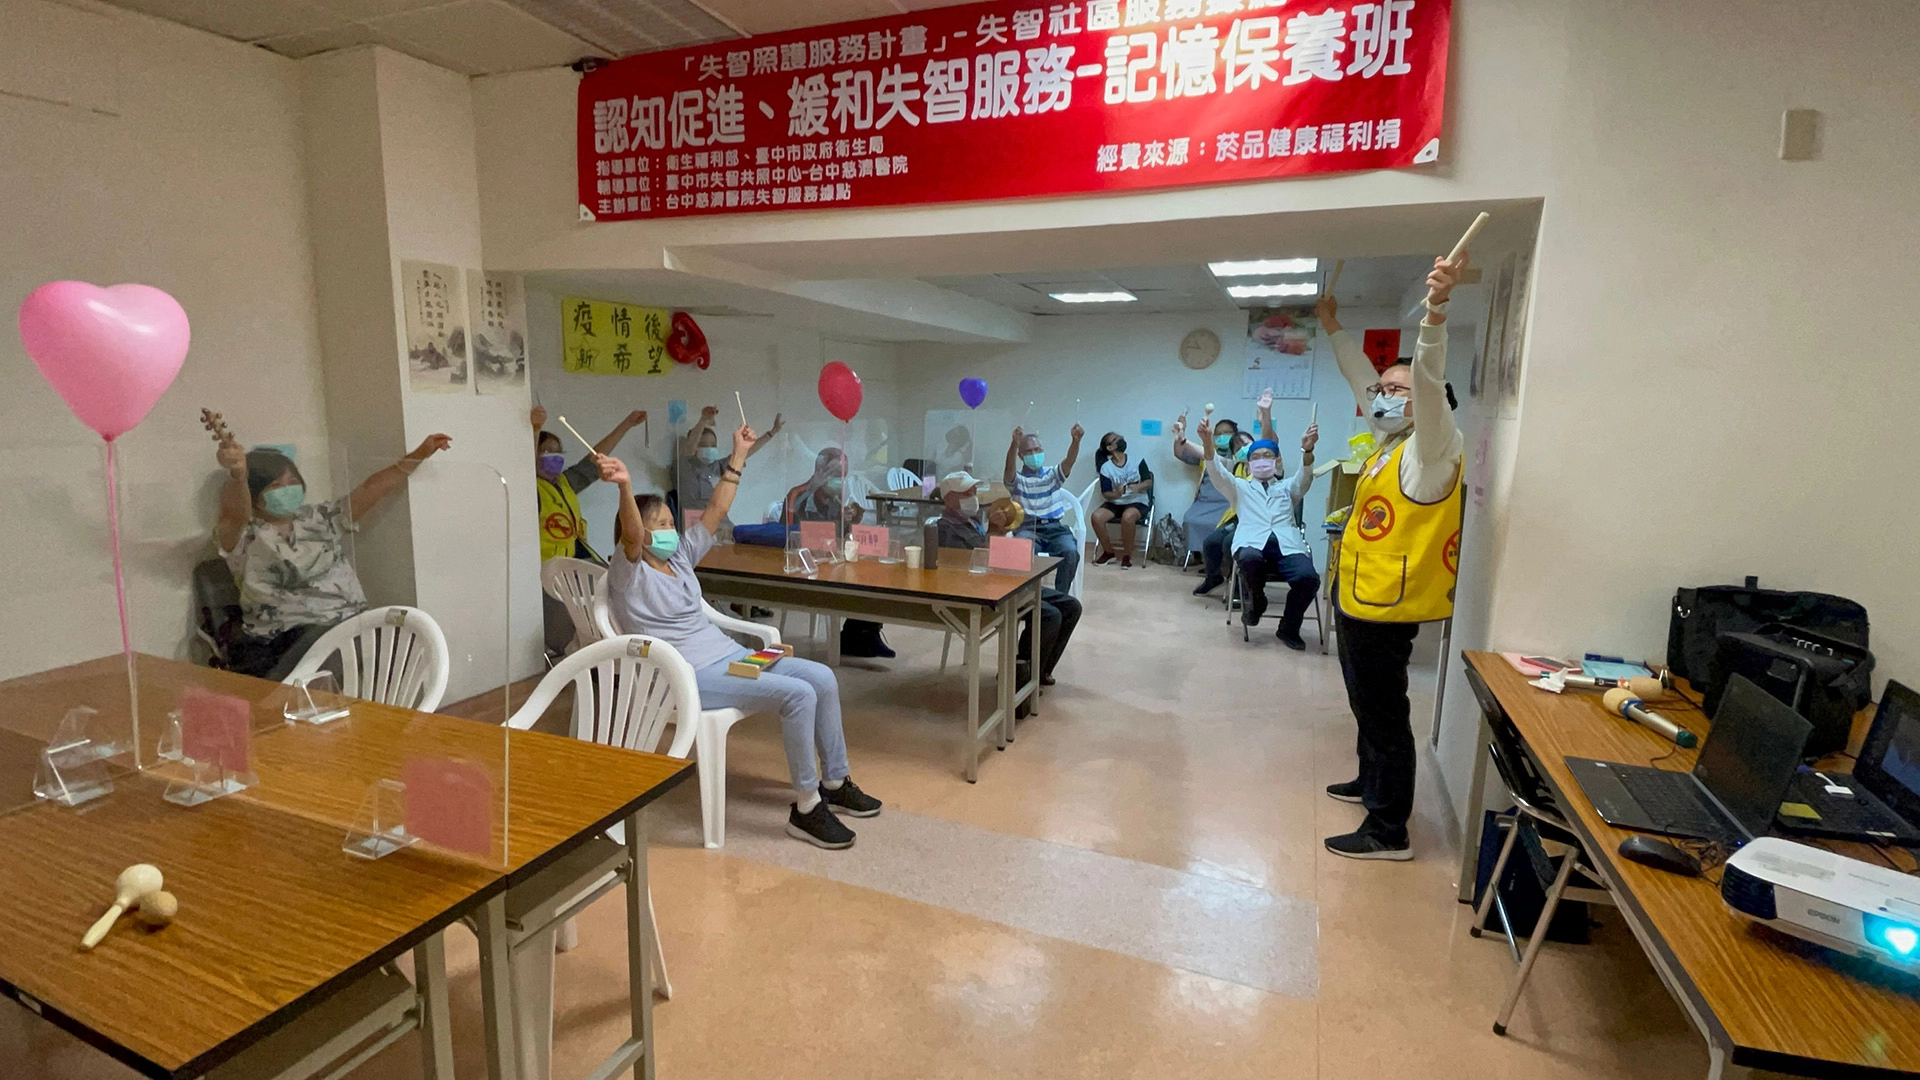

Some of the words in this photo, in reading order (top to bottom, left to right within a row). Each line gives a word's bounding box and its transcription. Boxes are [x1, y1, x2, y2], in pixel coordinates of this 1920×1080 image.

[573, 301, 665, 343] 疫情後
[578, 343, 664, 374] 新希望
